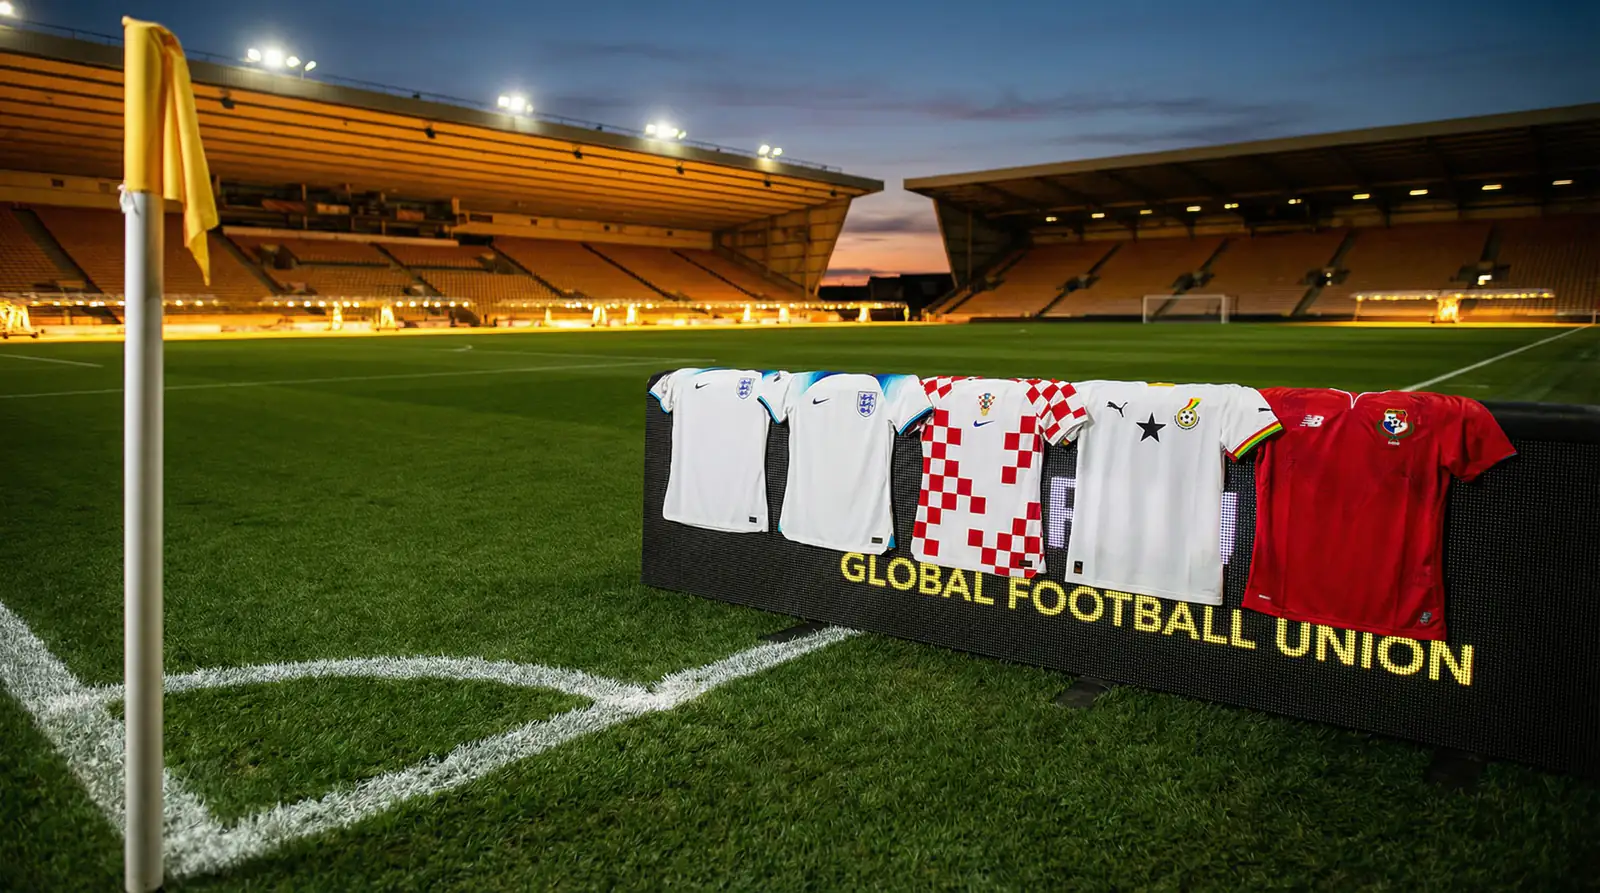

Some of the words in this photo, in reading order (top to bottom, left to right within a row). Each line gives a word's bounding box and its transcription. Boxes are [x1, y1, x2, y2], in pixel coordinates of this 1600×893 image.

[840, 552, 994, 605] GLOBAL
[1007, 576, 1256, 649] FOOTBALL
[1276, 617, 1474, 686] UNION
